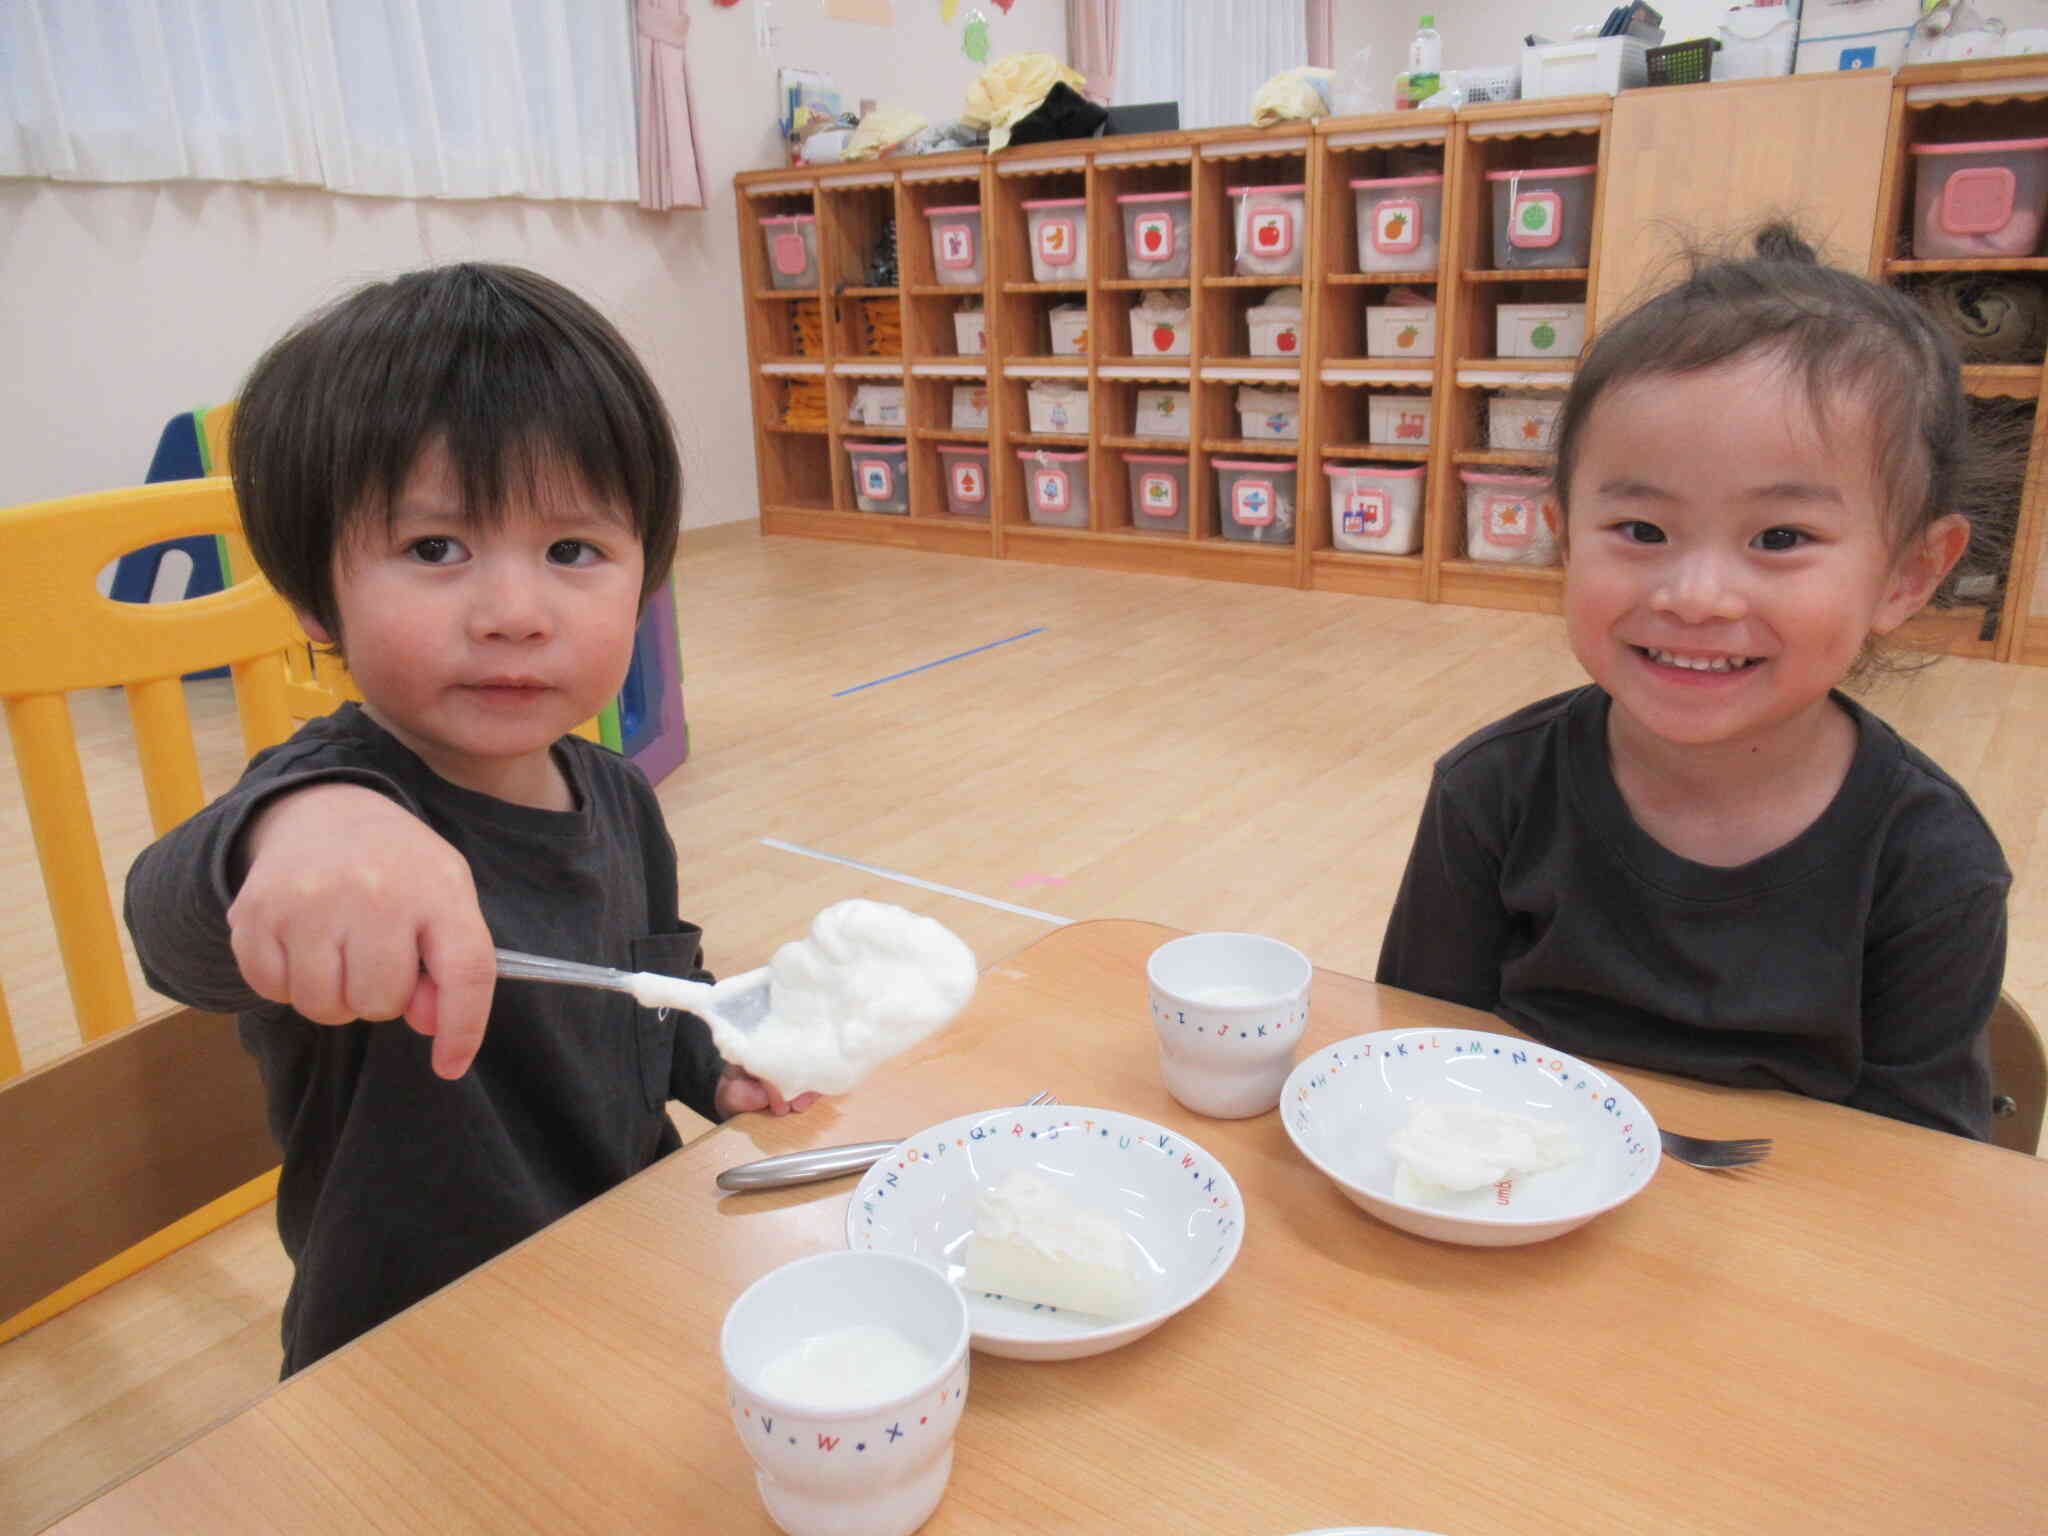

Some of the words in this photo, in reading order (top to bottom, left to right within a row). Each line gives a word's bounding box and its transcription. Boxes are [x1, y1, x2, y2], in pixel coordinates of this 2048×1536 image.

[1256, 1023, 1268, 1038] K
[1362, 1044, 1373, 1056] J
[1397, 1043, 1408, 1056] K
[1470, 1039, 1482, 1054] M
[1512, 1050, 1527, 1065] N
[1550, 1060, 1563, 1072] O
[1604, 1096, 1616, 1113] Q
[885, 1171, 899, 1188] N
[907, 1149, 919, 1162] O
[970, 1126, 986, 1140] Q
[1011, 1123, 1024, 1137] R
[1119, 1135, 1131, 1150] U
[1159, 1134, 1170, 1149] V
[1203, 1177, 1215, 1192] X
[760, 1415, 773, 1434] V
[816, 1433, 841, 1452] W
[885, 1421, 905, 1444] X
